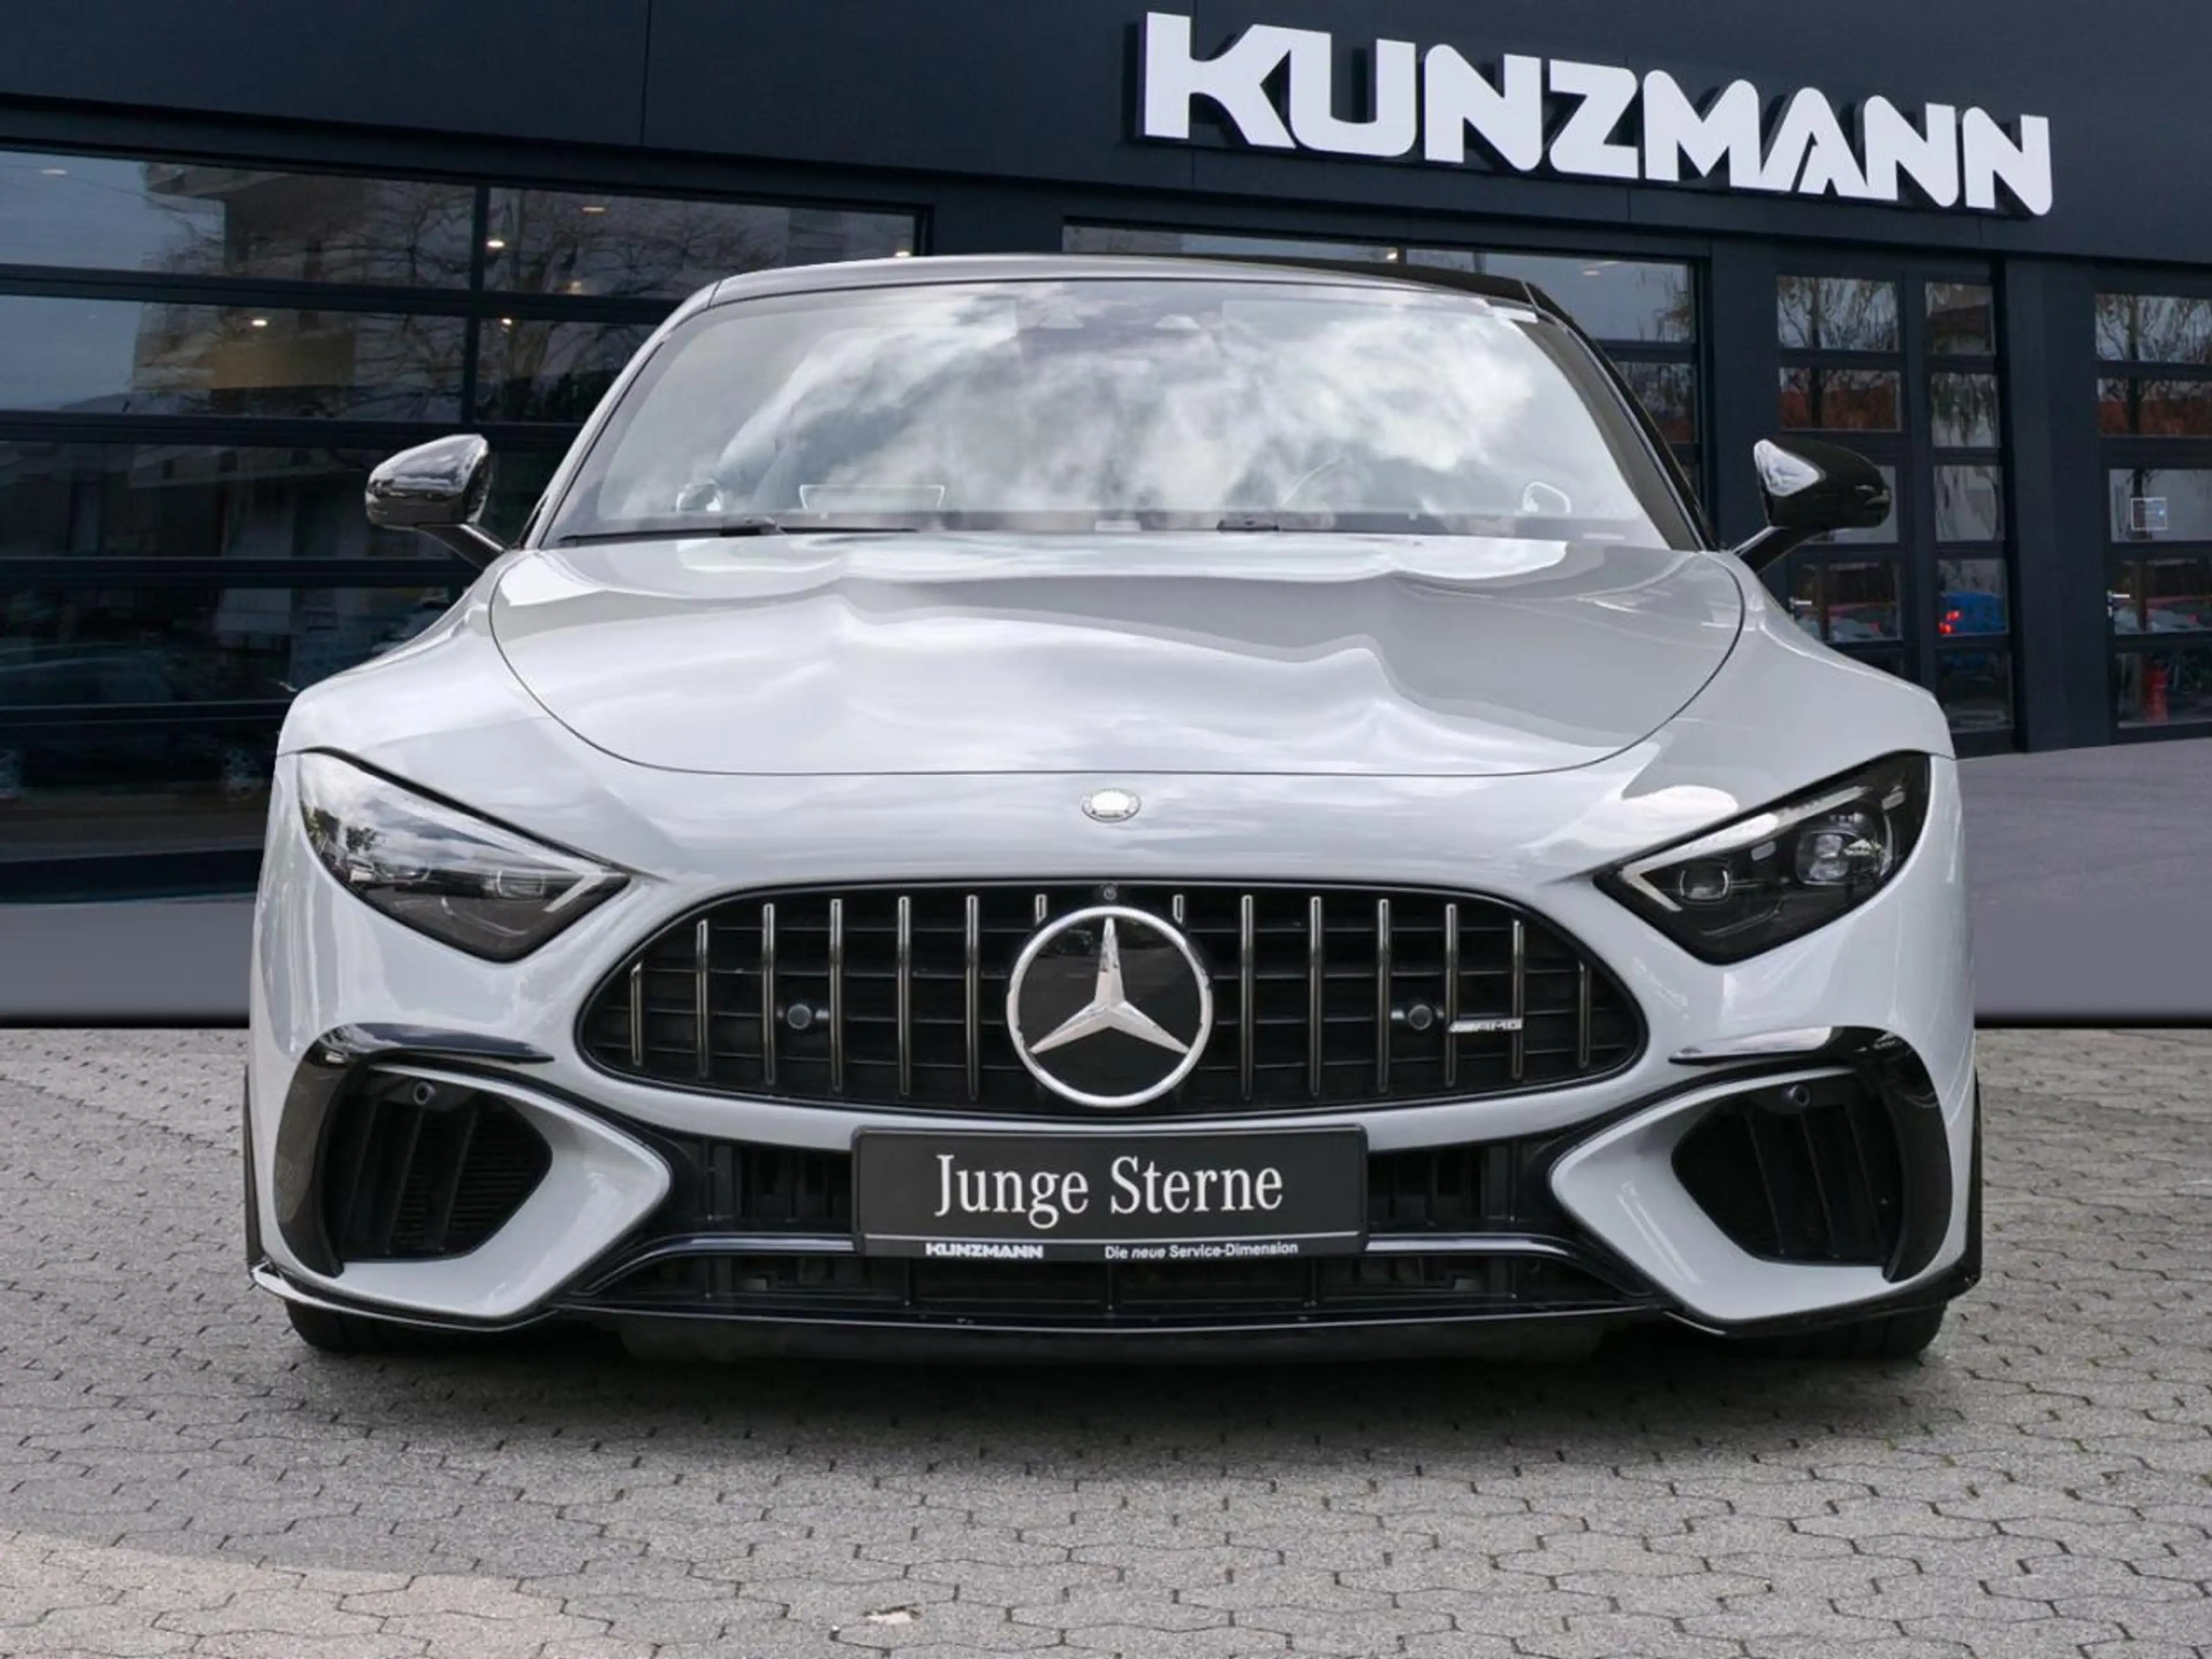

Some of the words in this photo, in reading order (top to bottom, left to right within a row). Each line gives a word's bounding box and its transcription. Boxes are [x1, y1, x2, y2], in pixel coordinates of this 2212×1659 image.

[1145, 12, 2053, 215] KUNZMANN
[934, 1154, 1089, 1229] Junge
[1110, 1156, 1283, 1214] Sterne
[925, 1243, 1044, 1259] KUNZMANN
[1104, 1245, 1128, 1259] Die
[1131, 1247, 1166, 1259] neue
[1169, 1241, 1299, 1258] Service-Dimension
